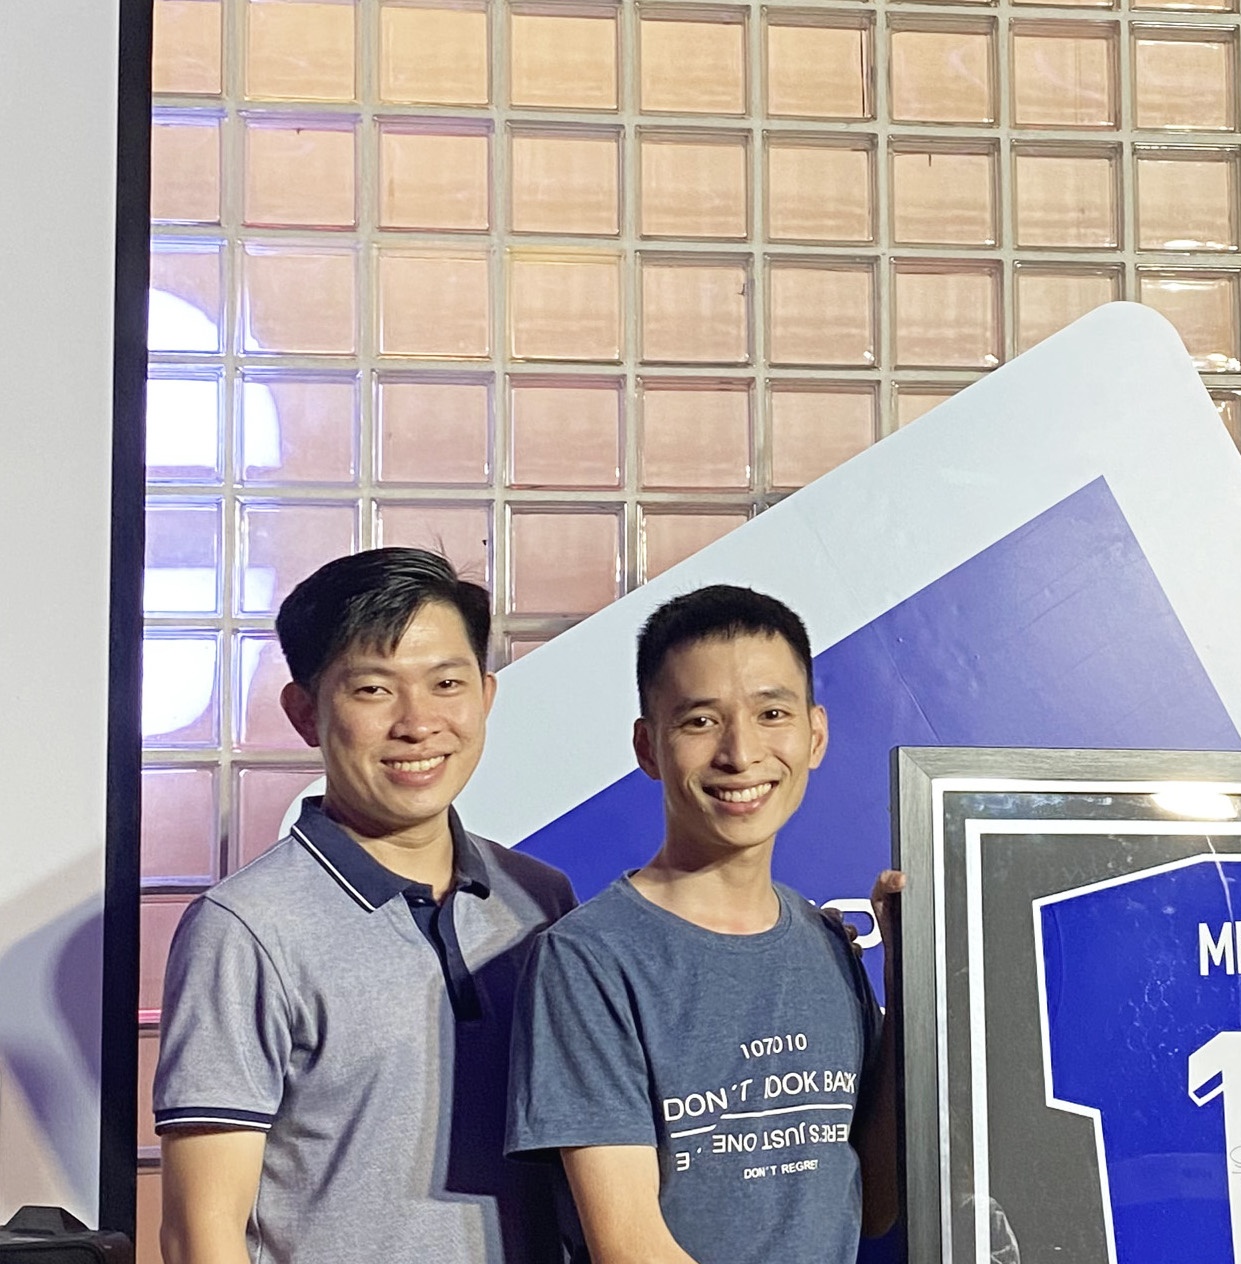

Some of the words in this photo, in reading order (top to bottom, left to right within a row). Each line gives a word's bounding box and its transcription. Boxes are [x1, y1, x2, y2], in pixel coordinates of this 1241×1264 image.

[712, 1133, 757, 1155] ONE
[761, 1122, 806, 1151] JUST
[744, 1165, 777, 1179] DON'T
